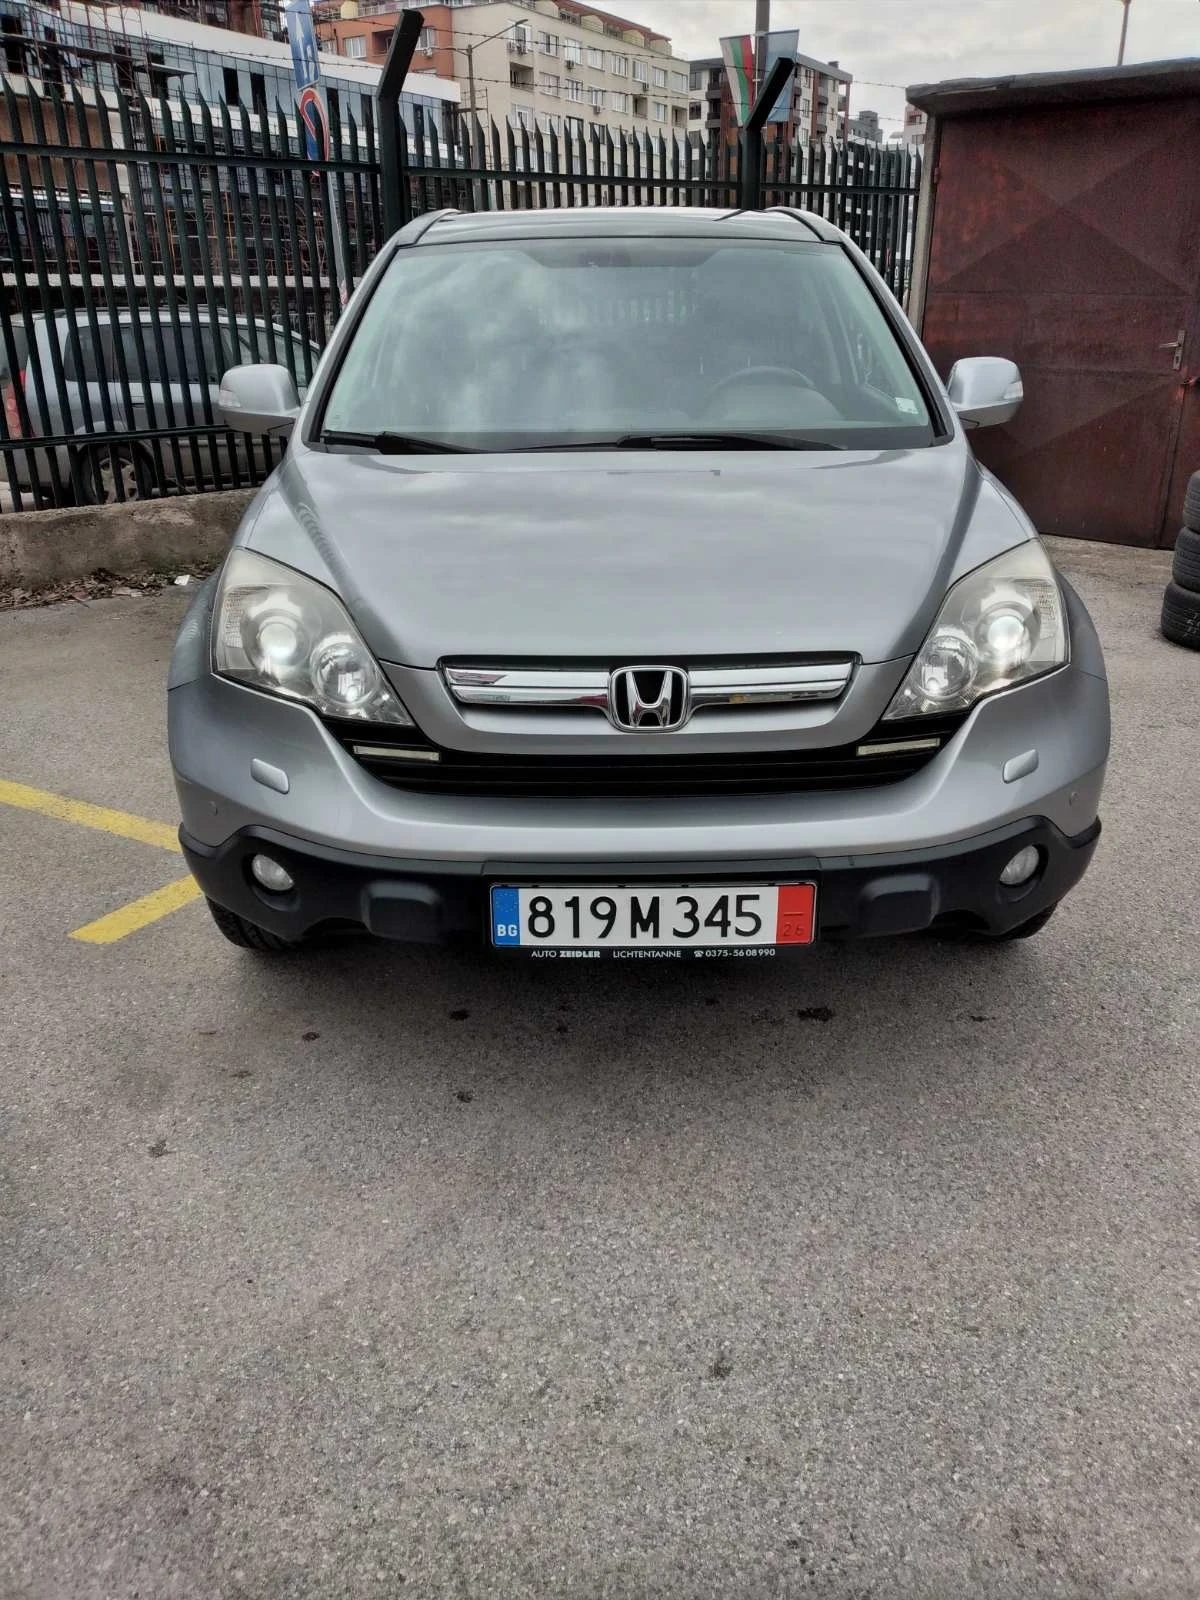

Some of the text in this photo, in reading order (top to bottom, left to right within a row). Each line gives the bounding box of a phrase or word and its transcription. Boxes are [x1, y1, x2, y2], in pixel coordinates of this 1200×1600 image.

[497, 924, 518, 937] BG
[531, 950, 557, 958] AUTO
[559, 950, 601, 958] ZEIDLER
[613, 950, 682, 958] LICHTENTANNE
